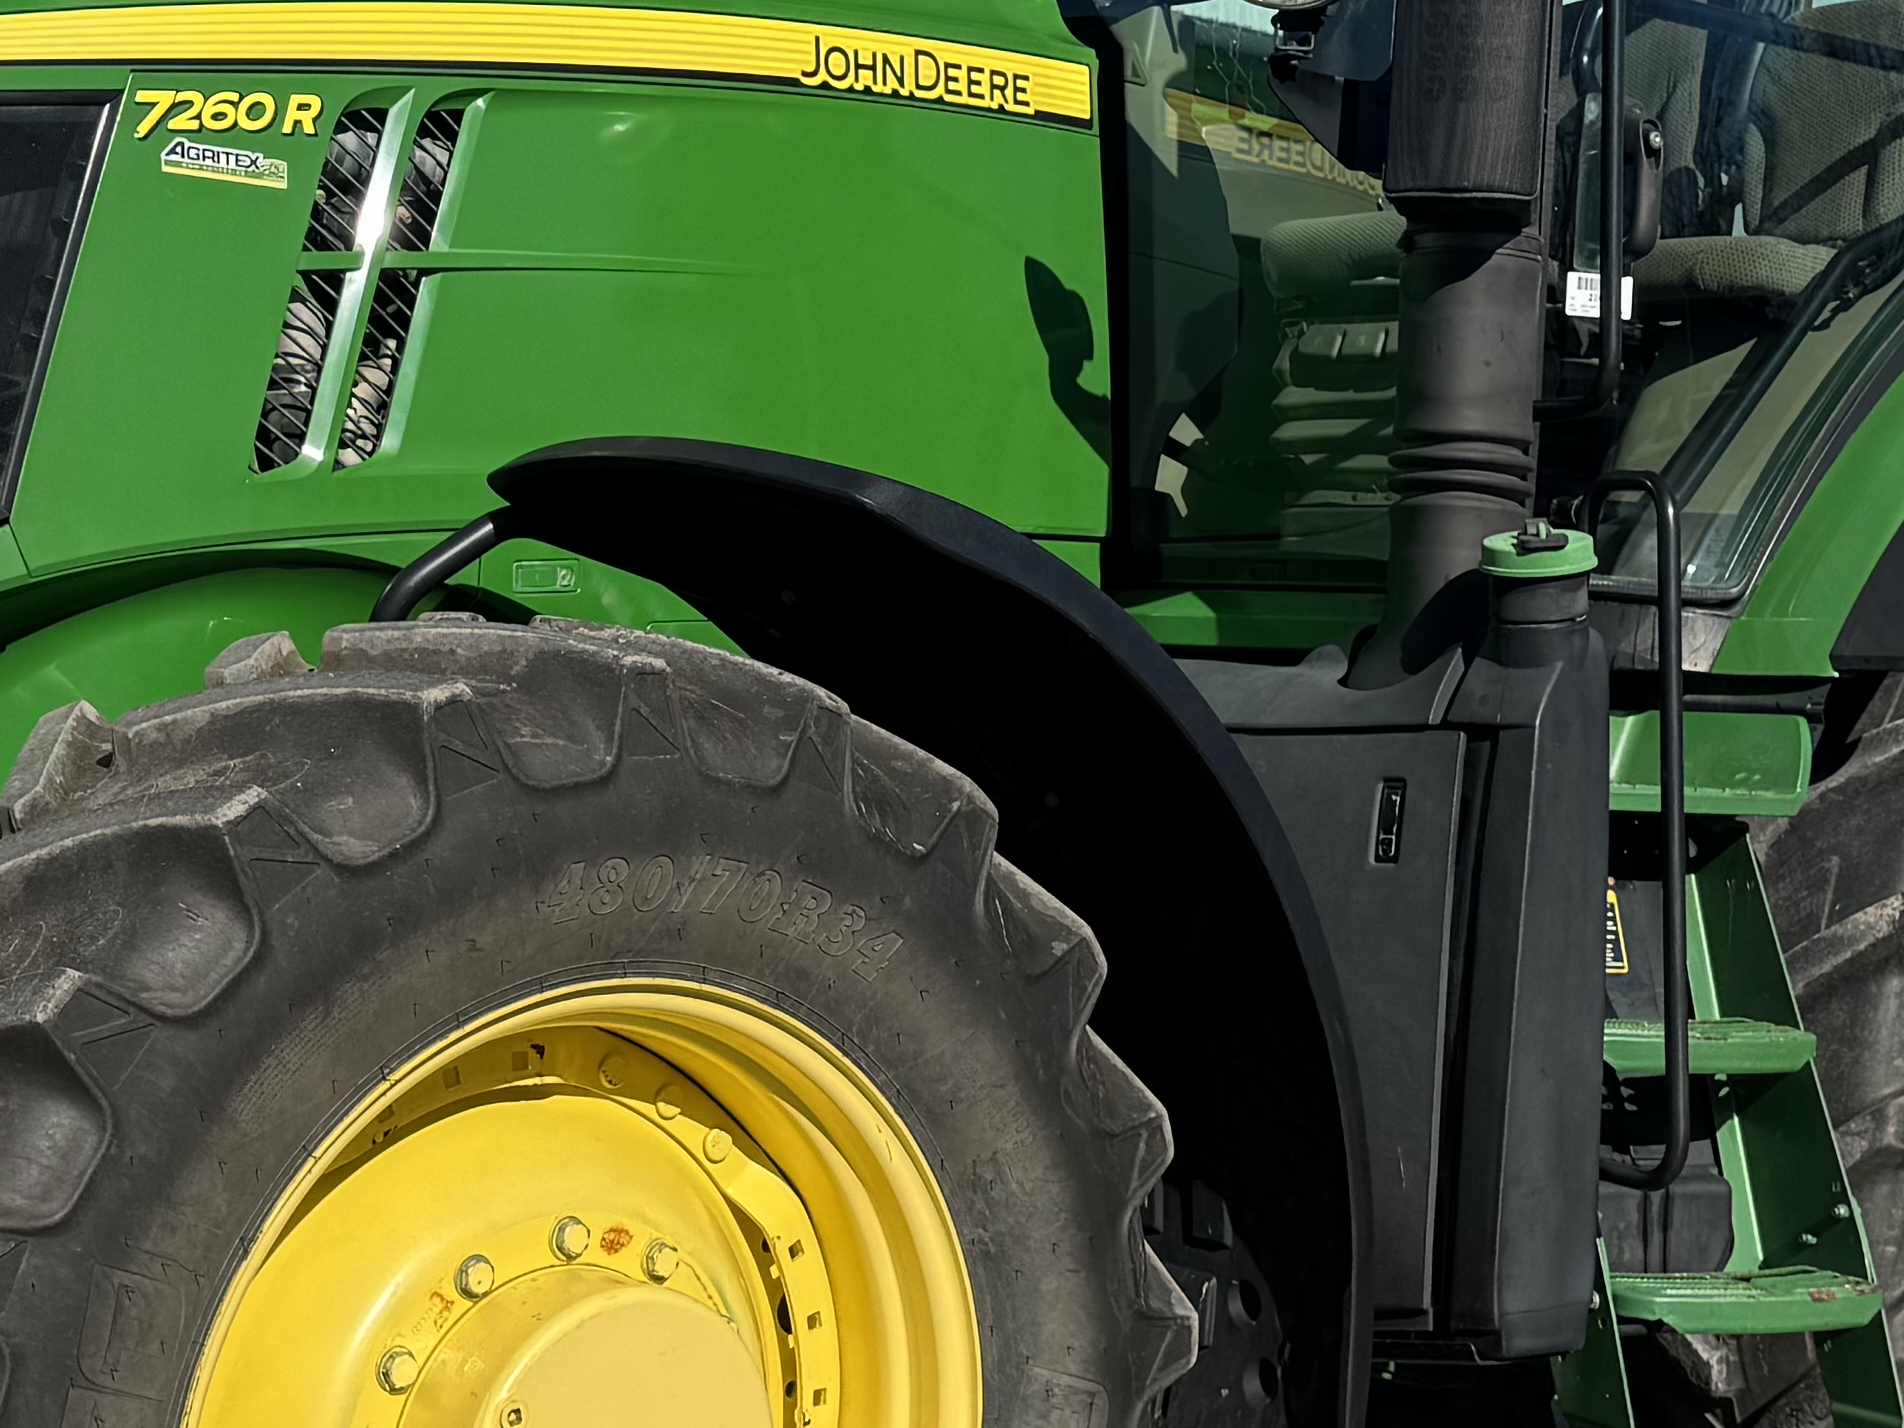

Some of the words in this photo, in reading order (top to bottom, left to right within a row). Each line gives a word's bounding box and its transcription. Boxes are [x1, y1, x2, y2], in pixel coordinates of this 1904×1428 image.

[799, 34, 906, 90] JOHN
[913, 48, 1033, 109] DEERE
[133, 89, 278, 139] 7260
[281, 93, 323, 136] R
[165, 140, 261, 171] AGRITEX
[546, 853, 905, 983] 480/70R34
